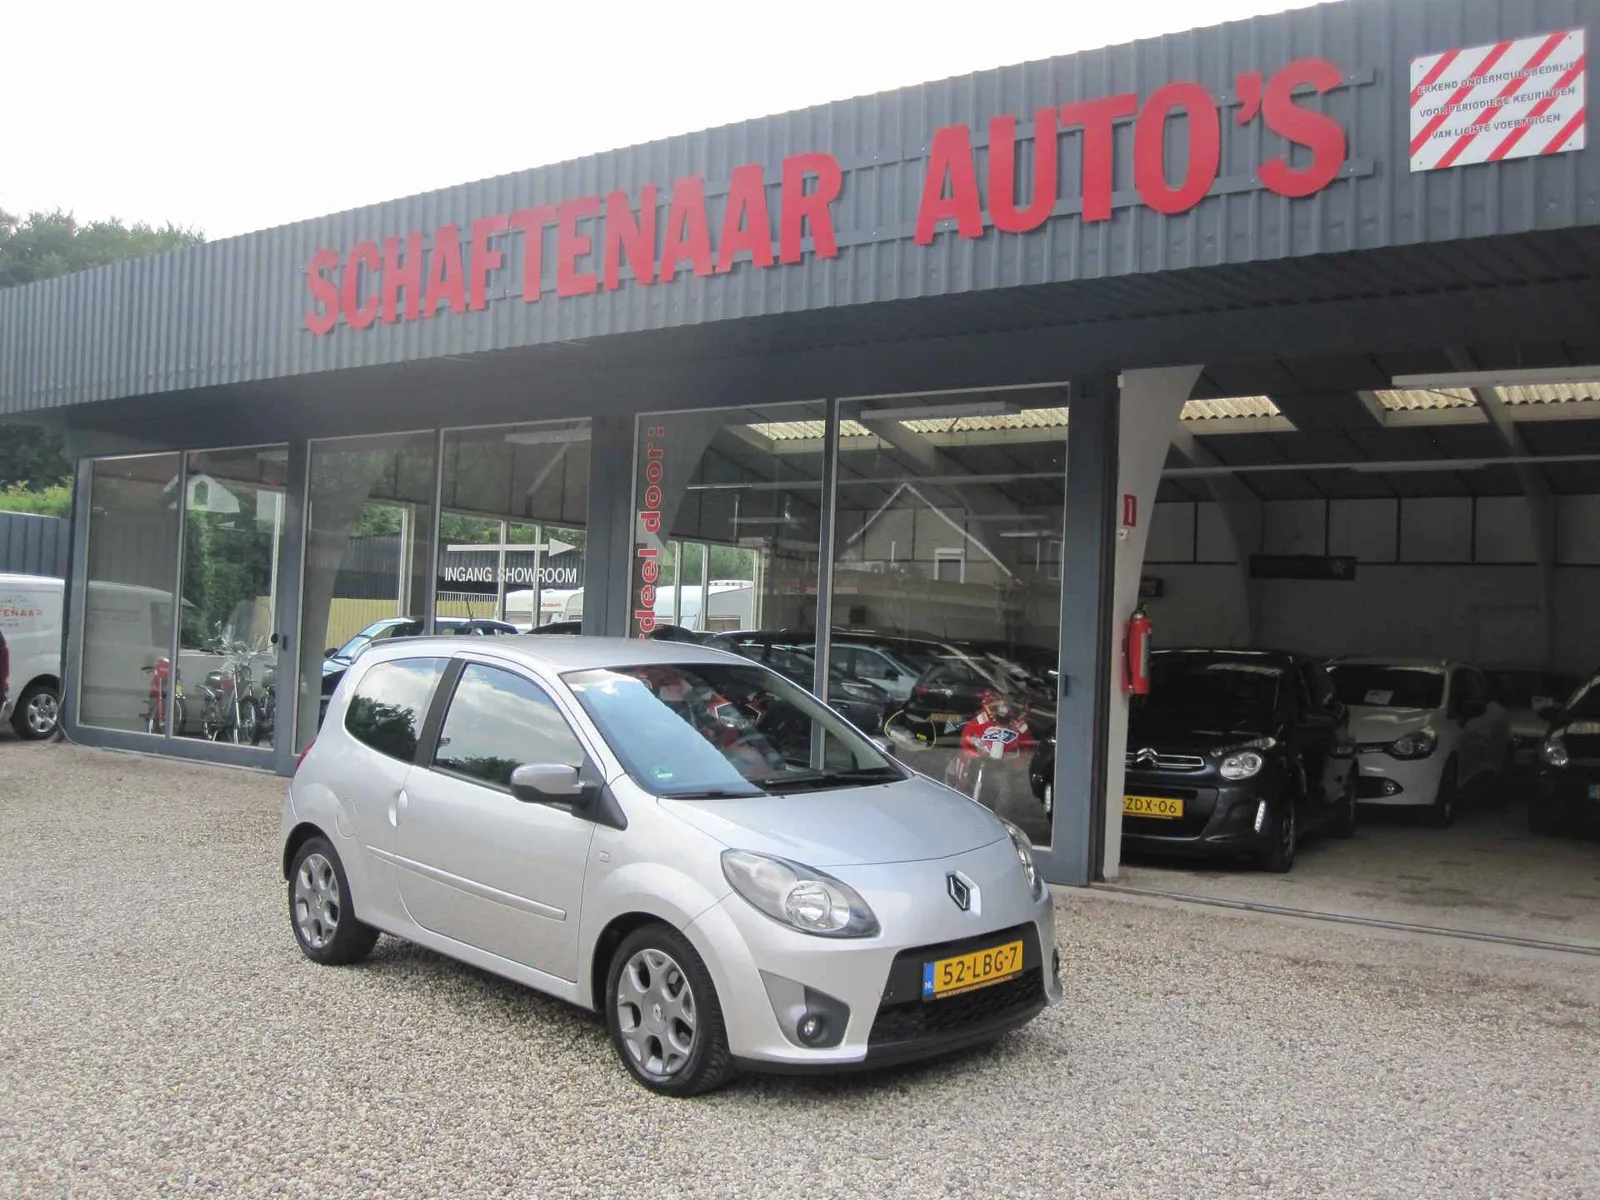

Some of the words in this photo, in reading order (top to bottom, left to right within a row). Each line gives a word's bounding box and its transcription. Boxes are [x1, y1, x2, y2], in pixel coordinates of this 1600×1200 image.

[1417, 79, 1458, 96] ERKEND
[1460, 60, 1576, 88] ONDERHOUDSBEDRIJF
[1419, 103, 1447, 118] VOOR
[1449, 96, 1511, 114] PERIODIEKE
[1513, 86, 1576, 103] KEURINGEN
[1432, 128, 1452, 140] VAN
[1454, 122, 1491, 137] LICHTE
[1493, 113, 1561, 131] VOERTUIGEN
[305, 152, 843, 336] SCHAFTENAAR
[913, 56, 1346, 246] AUTO'S
[445, 566, 493, 582] INGANG
[497, 567, 577, 583] SHOWROOM
[943, 946, 1018, 986] 52-LBG-7
